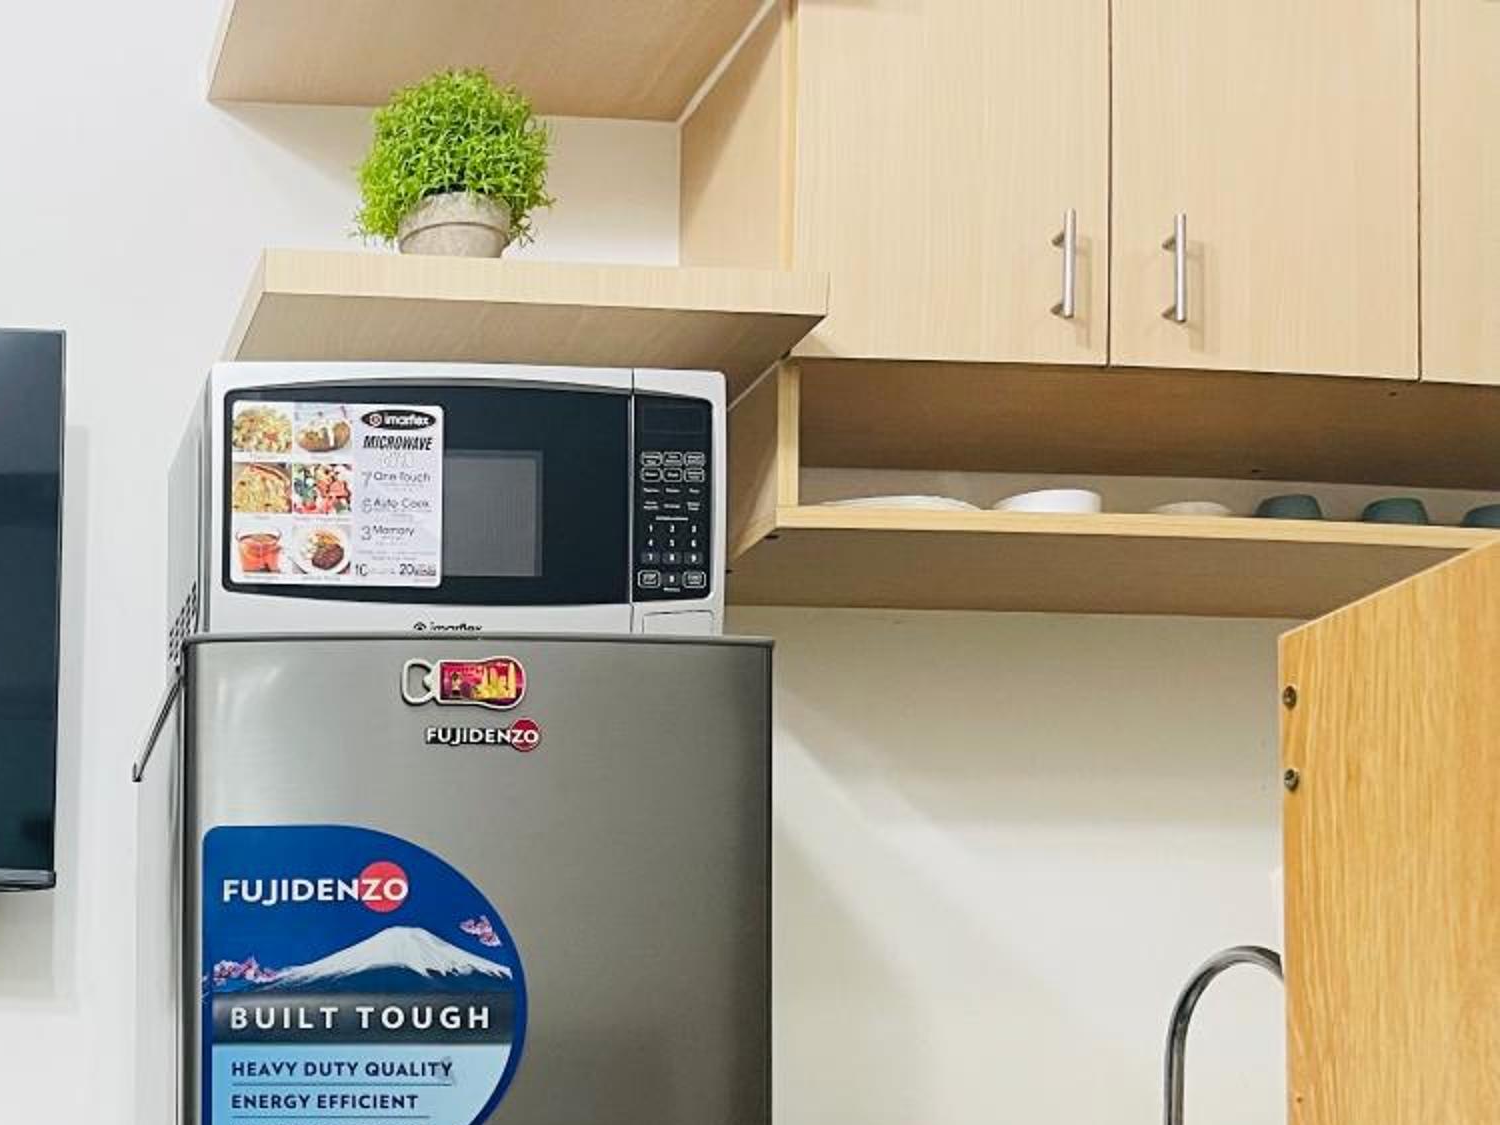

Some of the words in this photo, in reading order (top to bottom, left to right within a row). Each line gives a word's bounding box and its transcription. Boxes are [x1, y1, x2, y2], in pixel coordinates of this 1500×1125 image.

[363, 435, 433, 451] MICROWAVE
[399, 472, 432, 484] Touch
[361, 525, 372, 541] 3
[373, 525, 415, 537] Memory
[669, 524, 676, 533] 2
[426, 727, 540, 745] FUJIDENZO
[223, 879, 409, 906] FUJIDENZO
[230, 1006, 338, 1030] BUILT
[356, 1006, 490, 1030] TOUGH
[231, 1061, 298, 1077] HEAVY
[304, 1061, 359, 1077] DUTY
[365, 1061, 453, 1078] QUALITY
[231, 1094, 311, 1109] ENERGY
[316, 1094, 419, 1109] EFFICIENT
